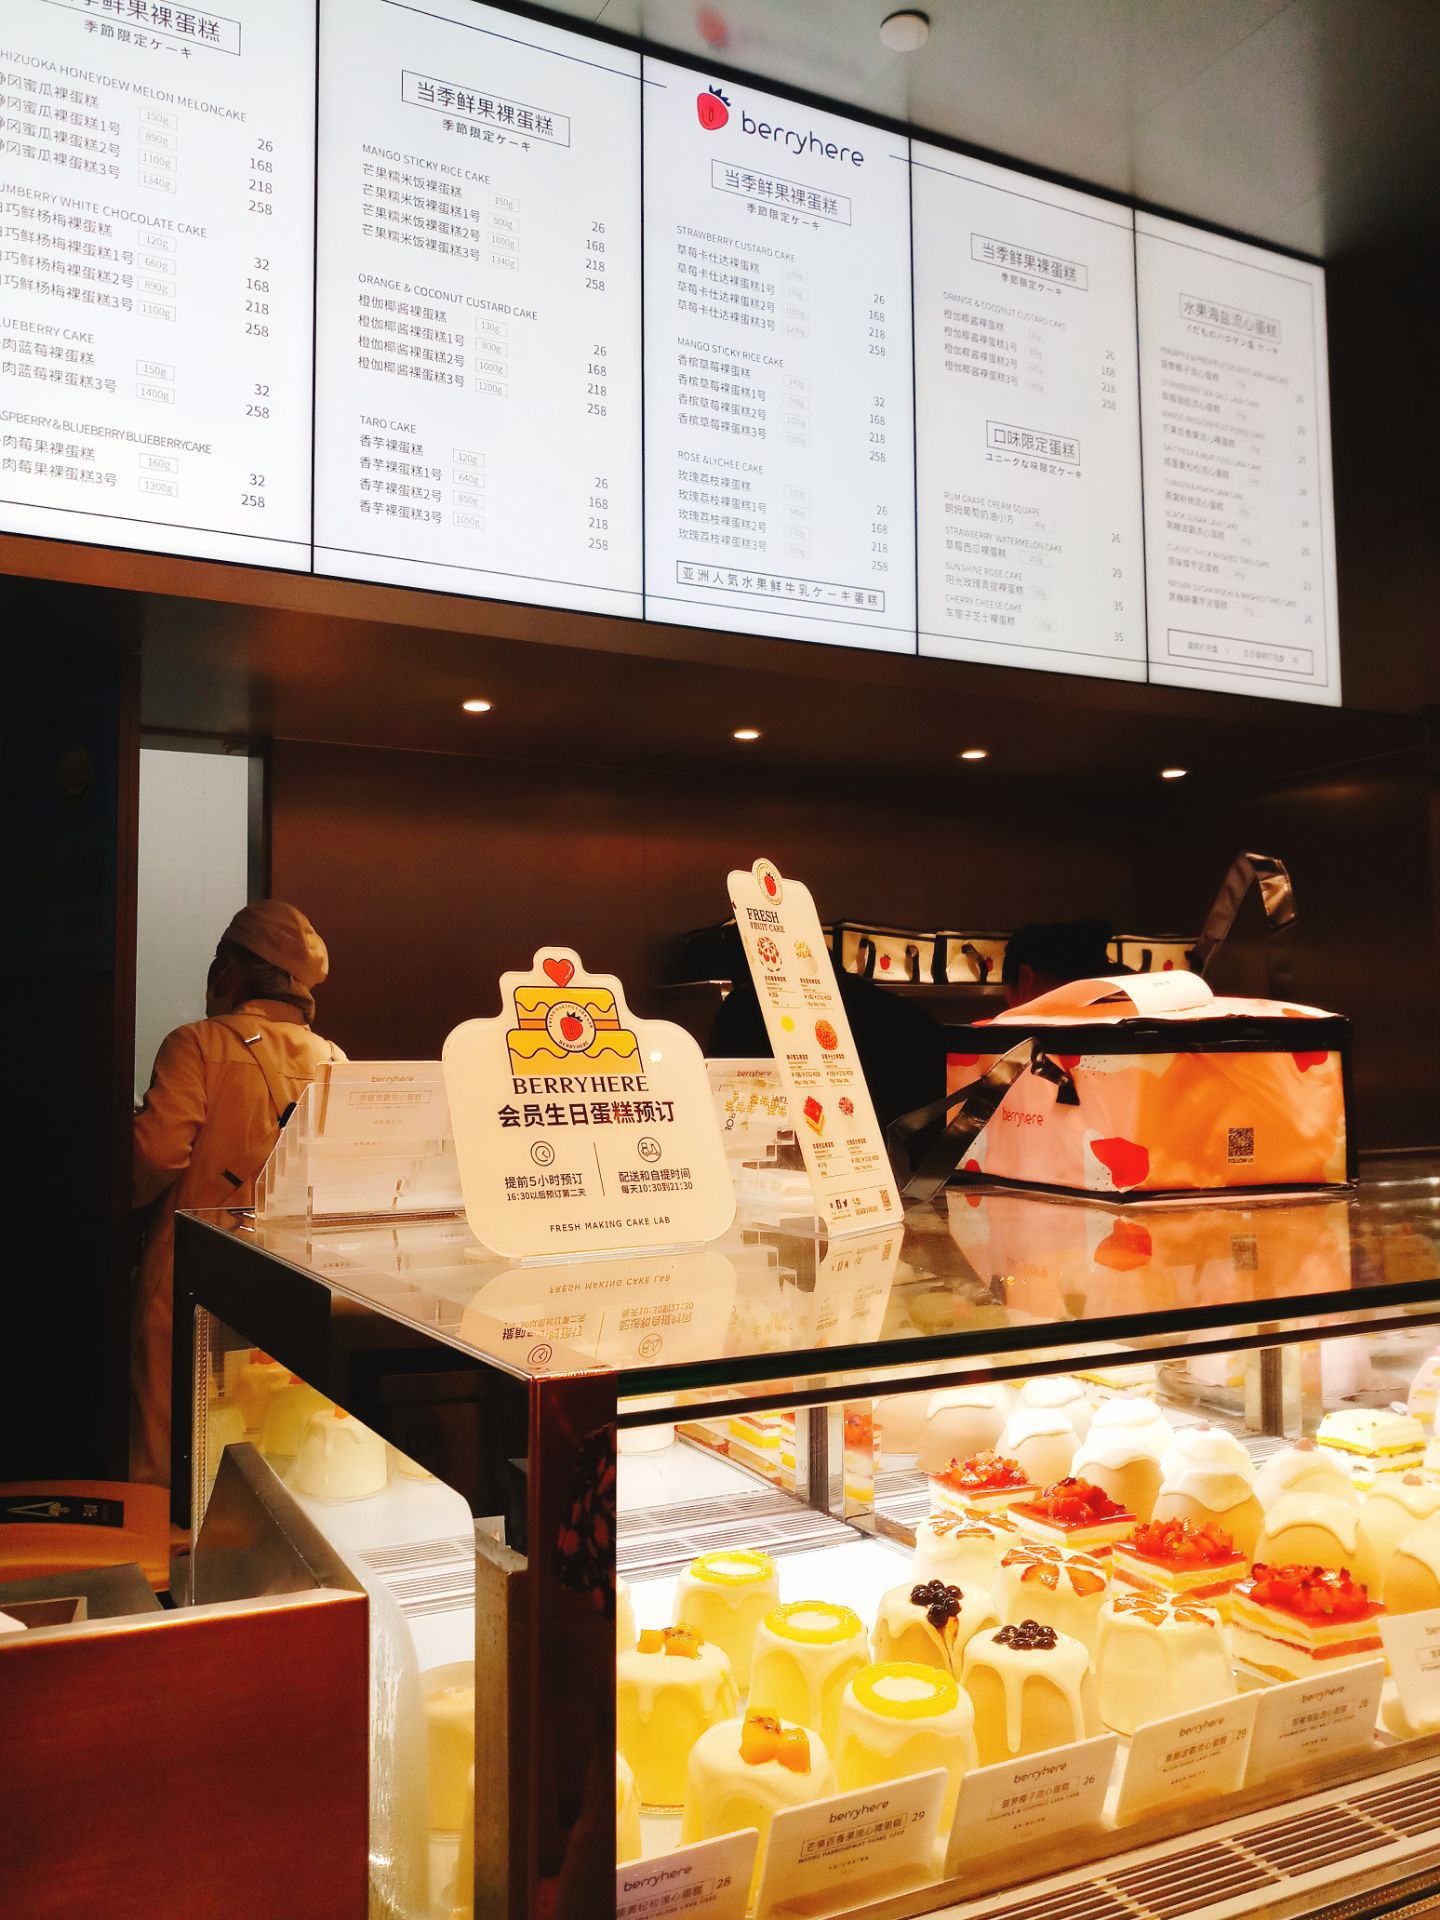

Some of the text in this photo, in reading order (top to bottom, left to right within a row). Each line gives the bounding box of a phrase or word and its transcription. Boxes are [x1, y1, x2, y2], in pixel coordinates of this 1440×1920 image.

[70, 0, 221, 42] 鲜果裸蛋糕
[84, 19, 192, 59] 季節限定ケーキ
[1, 49, 247, 123] HIZUOKA HONEYDEW MELON MELONCAKE
[417, 81, 554, 137] 当季鲜果裸蛋糕
[257, 138, 273, 152] 26
[442, 118, 531, 152] 季節限定ケーキ
[742, 111, 864, 167] berryhere
[249, 158, 273, 173] 168
[362, 143, 491, 185] MANGO STICKY RICE CAKE
[248, 200, 273, 215] 258
[249, 179, 273, 194] 218
[362, 163, 605, 234] 芒果糯米饭裸蛋糕 26
[725, 169, 839, 216] 当季鲜果裸蛋糕
[0, 202, 112, 237] 巧鲜杨梅裸蛋糕
[254, 257, 270, 271] 32
[60, 195, 99, 214] WHITE
[103, 206, 174, 231] CHOCOLATE
[177, 222, 207, 238] CAKE
[362, 183, 605, 253] 芒果糯米饭裸蛋糕1号 168
[362, 203, 605, 272] 芒果糯米饭裸蛋糕2号 218
[747, 203, 820, 230] 季節限定ケーキ
[0, 226, 270, 293] 巧鲜杨梅裸蛋糕1号 168
[362, 223, 605, 291] 芒果糯米饭裸蛋糕3号 258
[677, 225, 795, 262] STRAWBERRY CUSTARD CAKE
[983, 242, 1076, 282] 当季鲜果裸蛋糕
[0, 250, 270, 315] 巧鲜杨梅裸蛋糕2号 218
[677, 245, 885, 305] 草莓卡仕达裸蛋糕 26
[677, 262, 885, 322] 草莓卡仕达裸蛋糕1号 168
[0, 274, 269, 337] 巧鲜杨梅裸蛋糕3号 258
[358, 273, 538, 321] ORANGE & COCONUT CUSTARD CAKE
[677, 281, 885, 339] 草莓卡仕达裸蛋糕2号 218
[0, 317, 95, 344] UEBERRY CAKE
[677, 299, 885, 357] 草莓卡仕达裸蛋糕3号 258
[0, 338, 95, 366] 肉蓝莓裸蛋糕
[254, 384, 270, 397] 32
[587, 364, 607, 377] 168
[593, 345, 607, 357] 26
[677, 337, 784, 367] MANGO STICKY RICE CAKE
[0, 361, 117, 393] 肉蓝莓裸蛋糕3号
[246, 405, 270, 419] 258
[587, 384, 607, 397] 218
[677, 355, 885, 407] 香槟草莓裸蛋糕 32
[678, 374, 885, 426] 香槟草莓裸蛋糕1号 168
[0, 410, 52, 428] SPBERRY
[360, 415, 417, 434] TARO CAKE
[587, 403, 607, 417] 258
[678, 393, 885, 444] 香槟草莓裸蛋糕2号 218
[678, 412, 885, 463] 香槟草莓裸蛋糕3号 258
[994, 428, 1076, 459] 口味限定蛋糕
[0, 434, 96, 462] 肉莓果裸蛋糕
[249, 473, 265, 487] 32
[360, 434, 608, 490] 香芋裸蛋糕 26
[678, 451, 700, 463] ROSE
[742, 463, 763, 474] CAKE
[0, 457, 118, 487] 肉莓果裸蛋糕3号
[241, 494, 265, 508] 258
[360, 456, 608, 510] 香芋裸蛋糕1号 168
[678, 470, 887, 516] 玫瑰荔枝裸蛋糕 26
[360, 478, 608, 530] 香芋裸蛋糕2号 218
[678, 489, 887, 534] 玫瑰荔枝裸蛋糕1号 168
[360, 500, 608, 551] 香芋裸蛋糕3号 258
[678, 508, 888, 553] 玫瑰荔枝裸蛋糕2号 218
[678, 528, 888, 572] 玫瑰荔枝裸蛋糕3号 258
[683, 567, 879, 606] 亚洲人気水果鲜牛乳ケーキ蛋糕
[1113, 568, 1122, 578] 29
[1114, 632, 1123, 642] 35
[746, 908, 780, 924] FRESH
[512, 1076, 649, 1095] BERRYHERE
[498, 1101, 674, 1128] 会员生日蛋糕预订
[505, 1173, 583, 1189] 提前5小时预订
[507, 1188, 586, 1201] 16:30以后预订第二天
[618, 1168, 690, 1182] 配送和自提时间
[621, 1182, 693, 1194] 每天10:30到21:30
[550, 1216, 671, 1232] FRESH MAKING CAKE LAB
[829, 1801, 889, 1823] berryhere
[911, 1811, 925, 1822] 29
[624, 1866, 692, 1892] berryhere
[716, 1876, 731, 1889] 28
